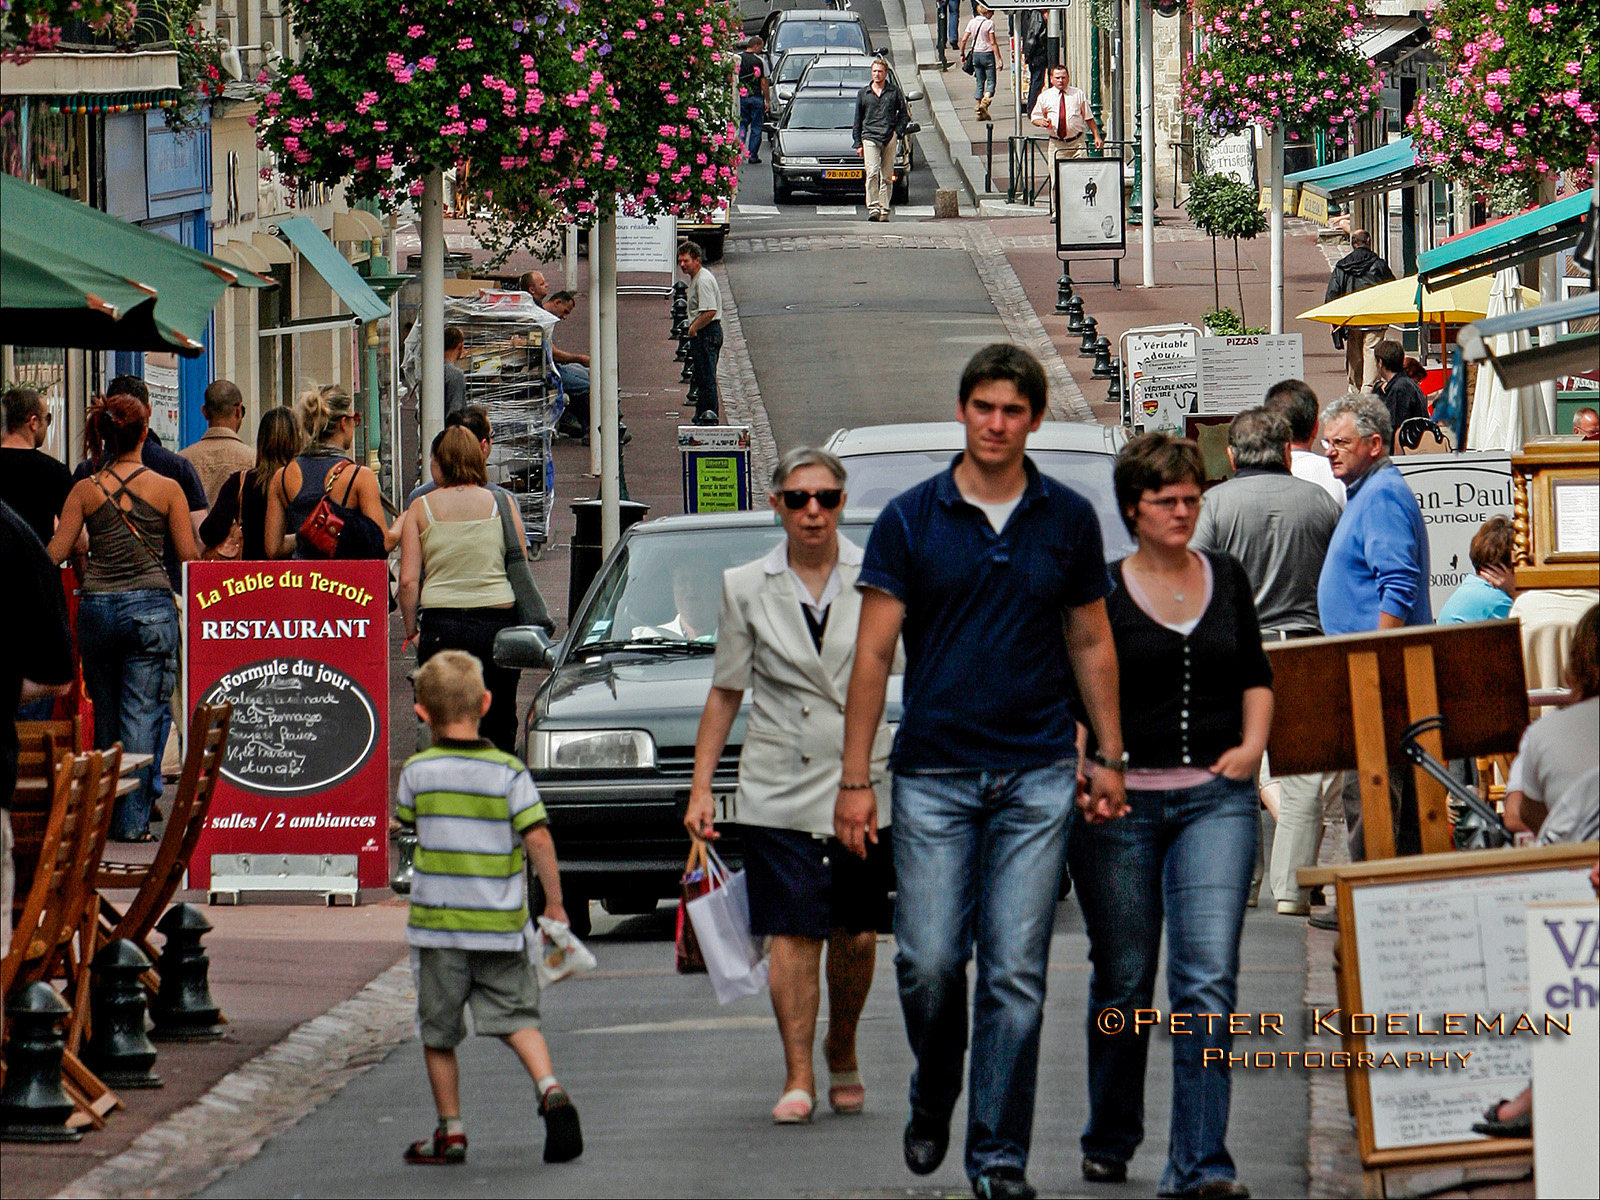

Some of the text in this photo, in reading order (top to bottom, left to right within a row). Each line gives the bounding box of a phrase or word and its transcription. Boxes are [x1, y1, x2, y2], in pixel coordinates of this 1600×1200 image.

[1143, 340, 1188, 350] Véritable
[1226, 337, 1259, 346] PIZZAS
[195, 570, 373, 610] La Table du Terroir
[201, 619, 370, 640] RESTAURANT
[219, 660, 350, 693] Formule du jour
[211, 811, 377, 832] salles / 2 ambiances
